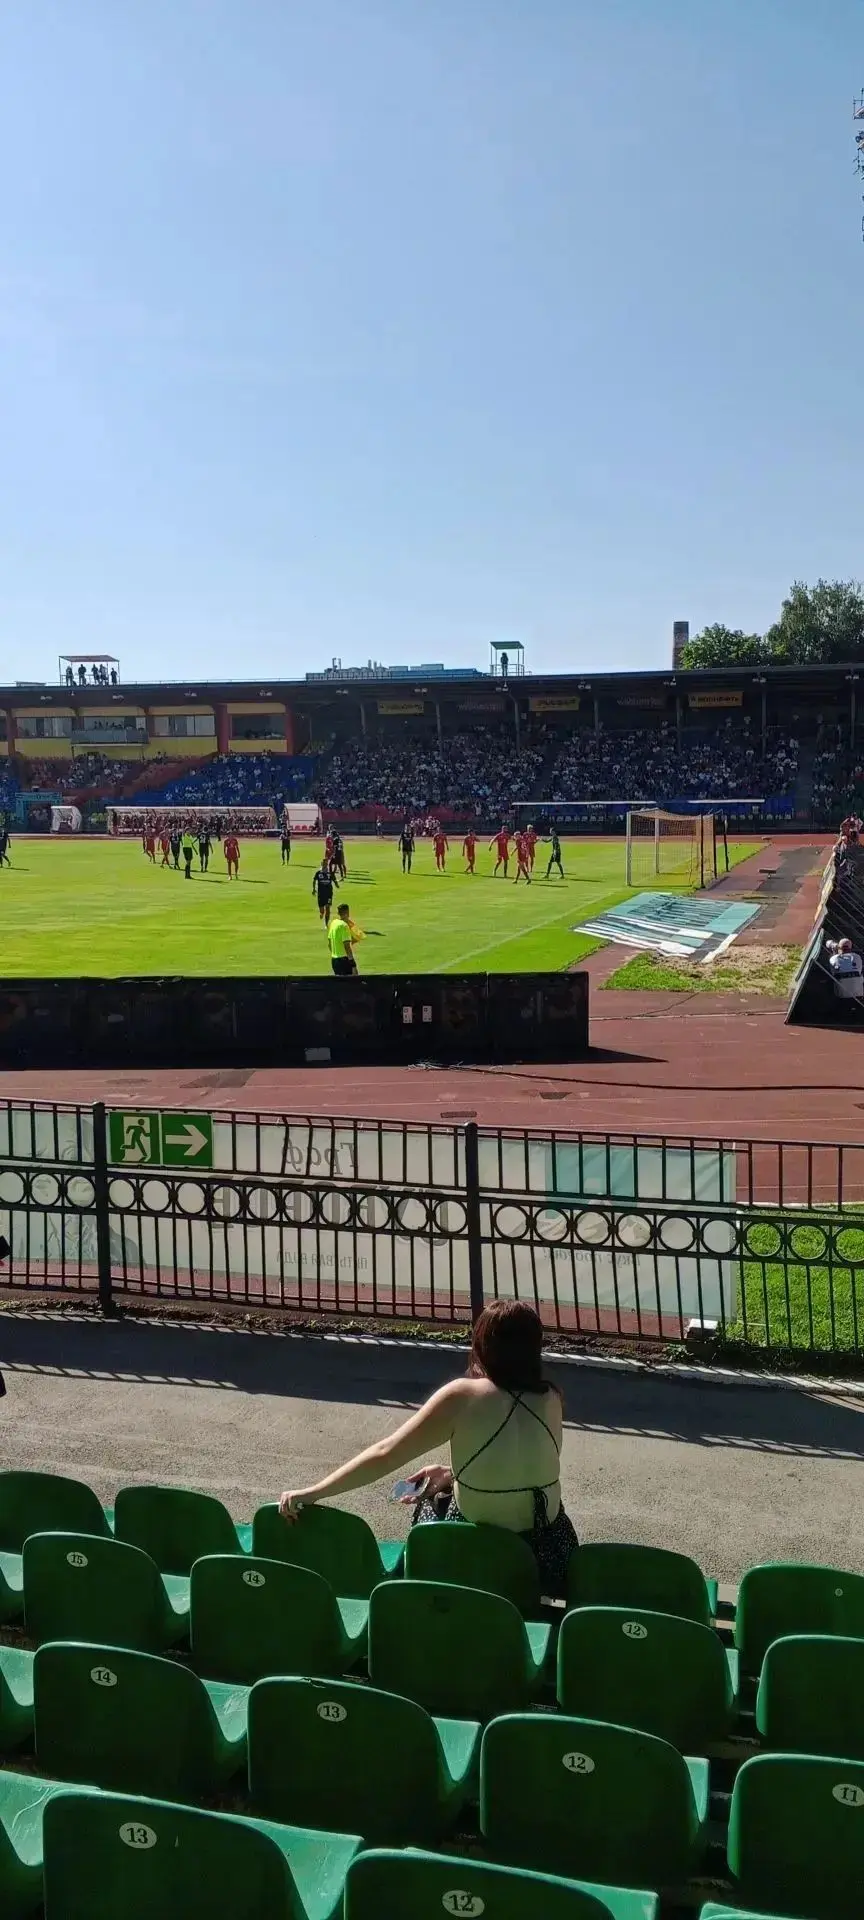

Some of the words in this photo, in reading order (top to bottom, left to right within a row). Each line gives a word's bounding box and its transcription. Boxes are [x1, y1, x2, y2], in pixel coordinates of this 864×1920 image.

[71, 1553, 84, 1564] 15
[246, 1573, 260, 1584] 14
[627, 1624, 641, 1636] 12
[95, 1669, 112, 1683] 14
[323, 1704, 340, 1718] 13
[569, 1756, 586, 1770] 12
[840, 1787, 858, 1803] 11
[126, 1826, 148, 1843] 13
[449, 1894, 474, 1912] 12
